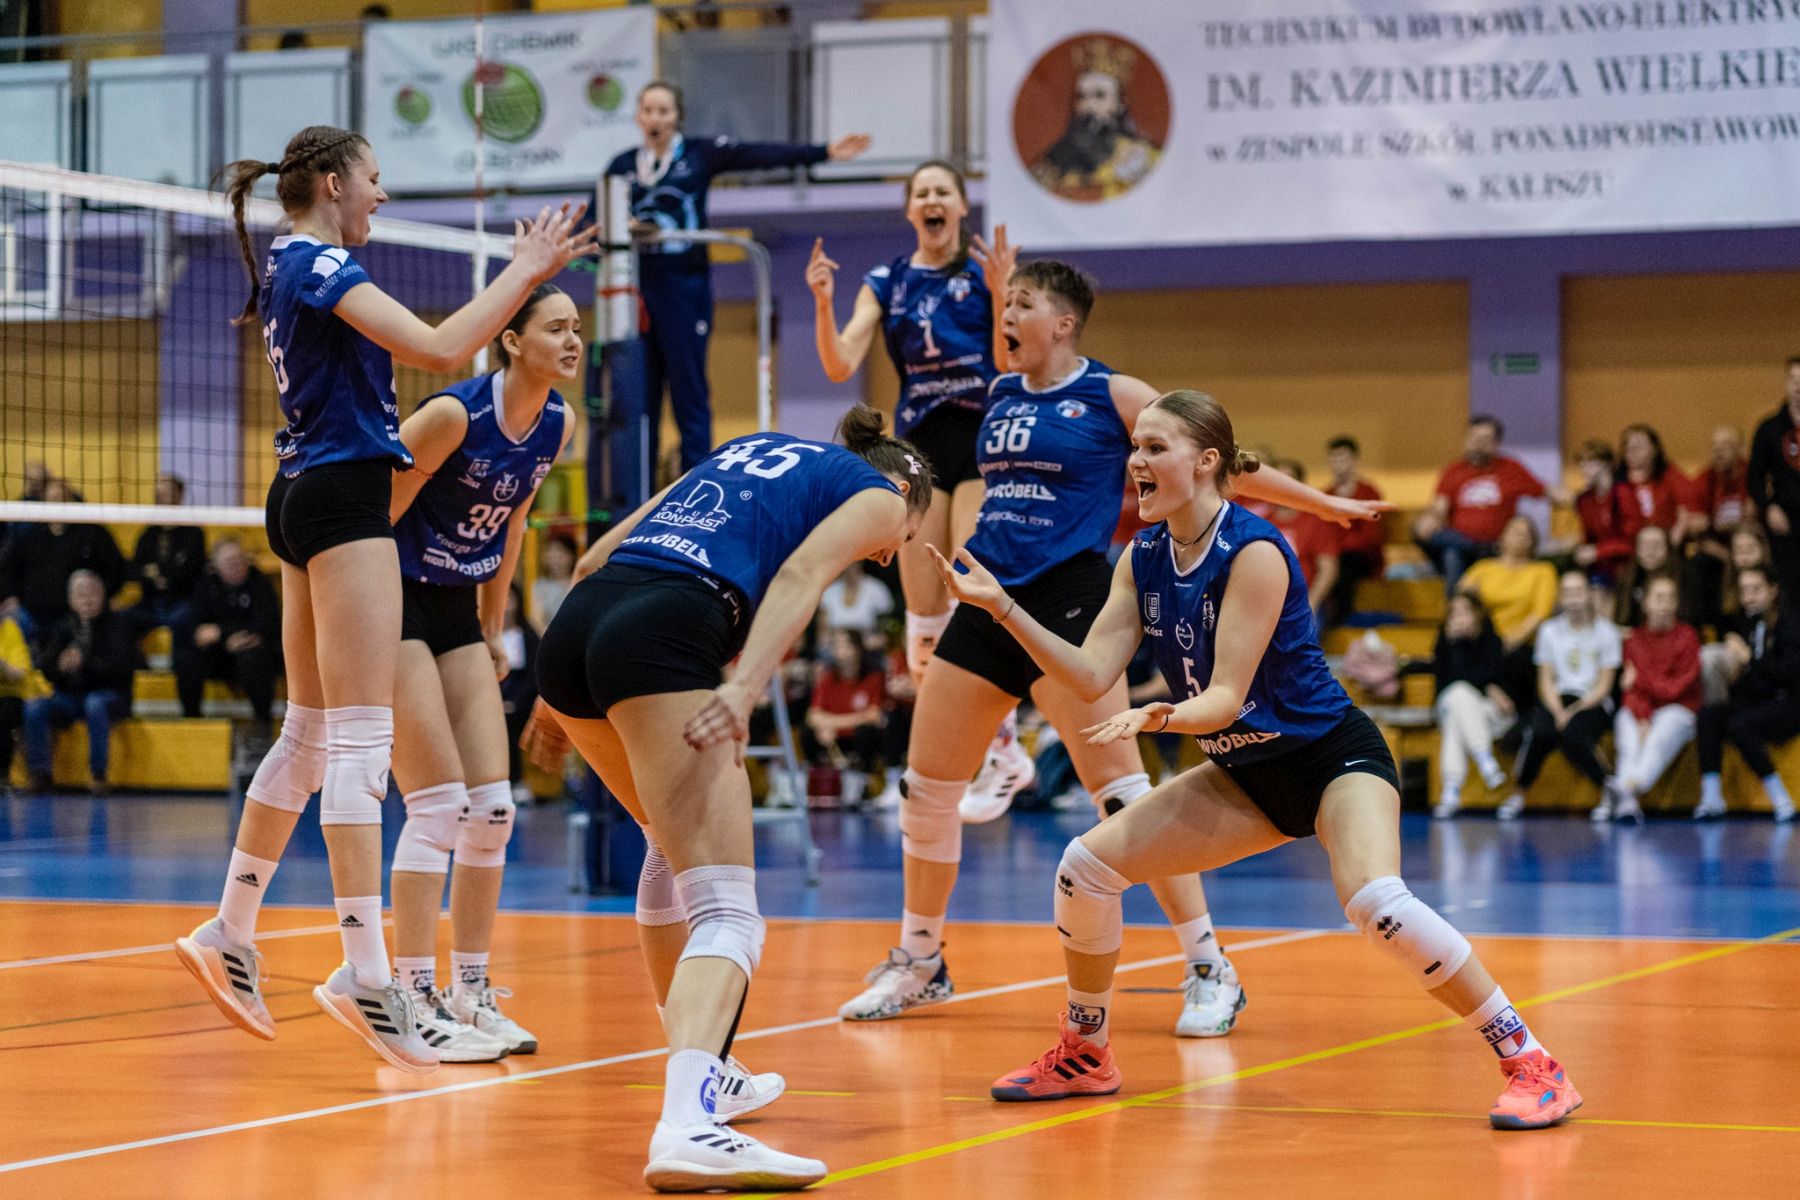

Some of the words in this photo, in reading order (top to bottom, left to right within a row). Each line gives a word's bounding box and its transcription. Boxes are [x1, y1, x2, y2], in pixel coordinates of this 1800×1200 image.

[1203, 14, 1399, 47] TECHNIKUM
[1290, 58, 1580, 108] KAZIMIERZA
[1235, 131, 1371, 163] ZESPOLE
[1479, 169, 1610, 202] KALISZU
[918, 319, 941, 358] 1
[985, 416, 1037, 454] 36
[712, 438, 826, 480] 45
[457, 503, 512, 541] 39
[1182, 656, 1202, 699] 5
[1070, 1012, 1099, 1023] LISZ
[1480, 1016, 1504, 1034] MKS
[1485, 1015, 1519, 1042] ALISZ
